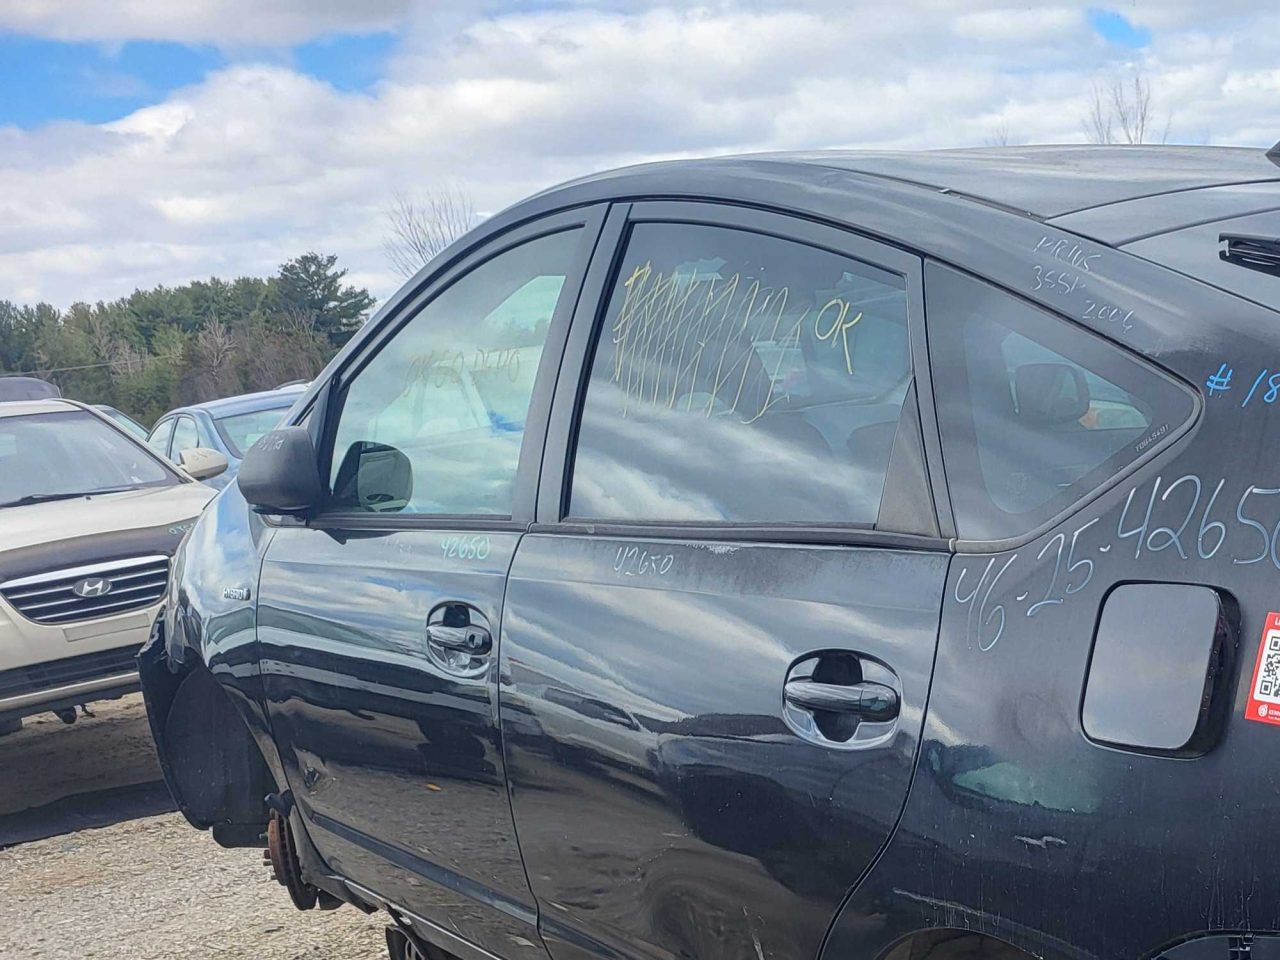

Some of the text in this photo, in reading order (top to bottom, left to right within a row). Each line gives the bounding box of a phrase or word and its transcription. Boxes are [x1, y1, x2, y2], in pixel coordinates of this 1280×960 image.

[814, 298, 863, 375] OK
[1206, 363, 1233, 399] #
[441, 535, 490, 559] 42650
